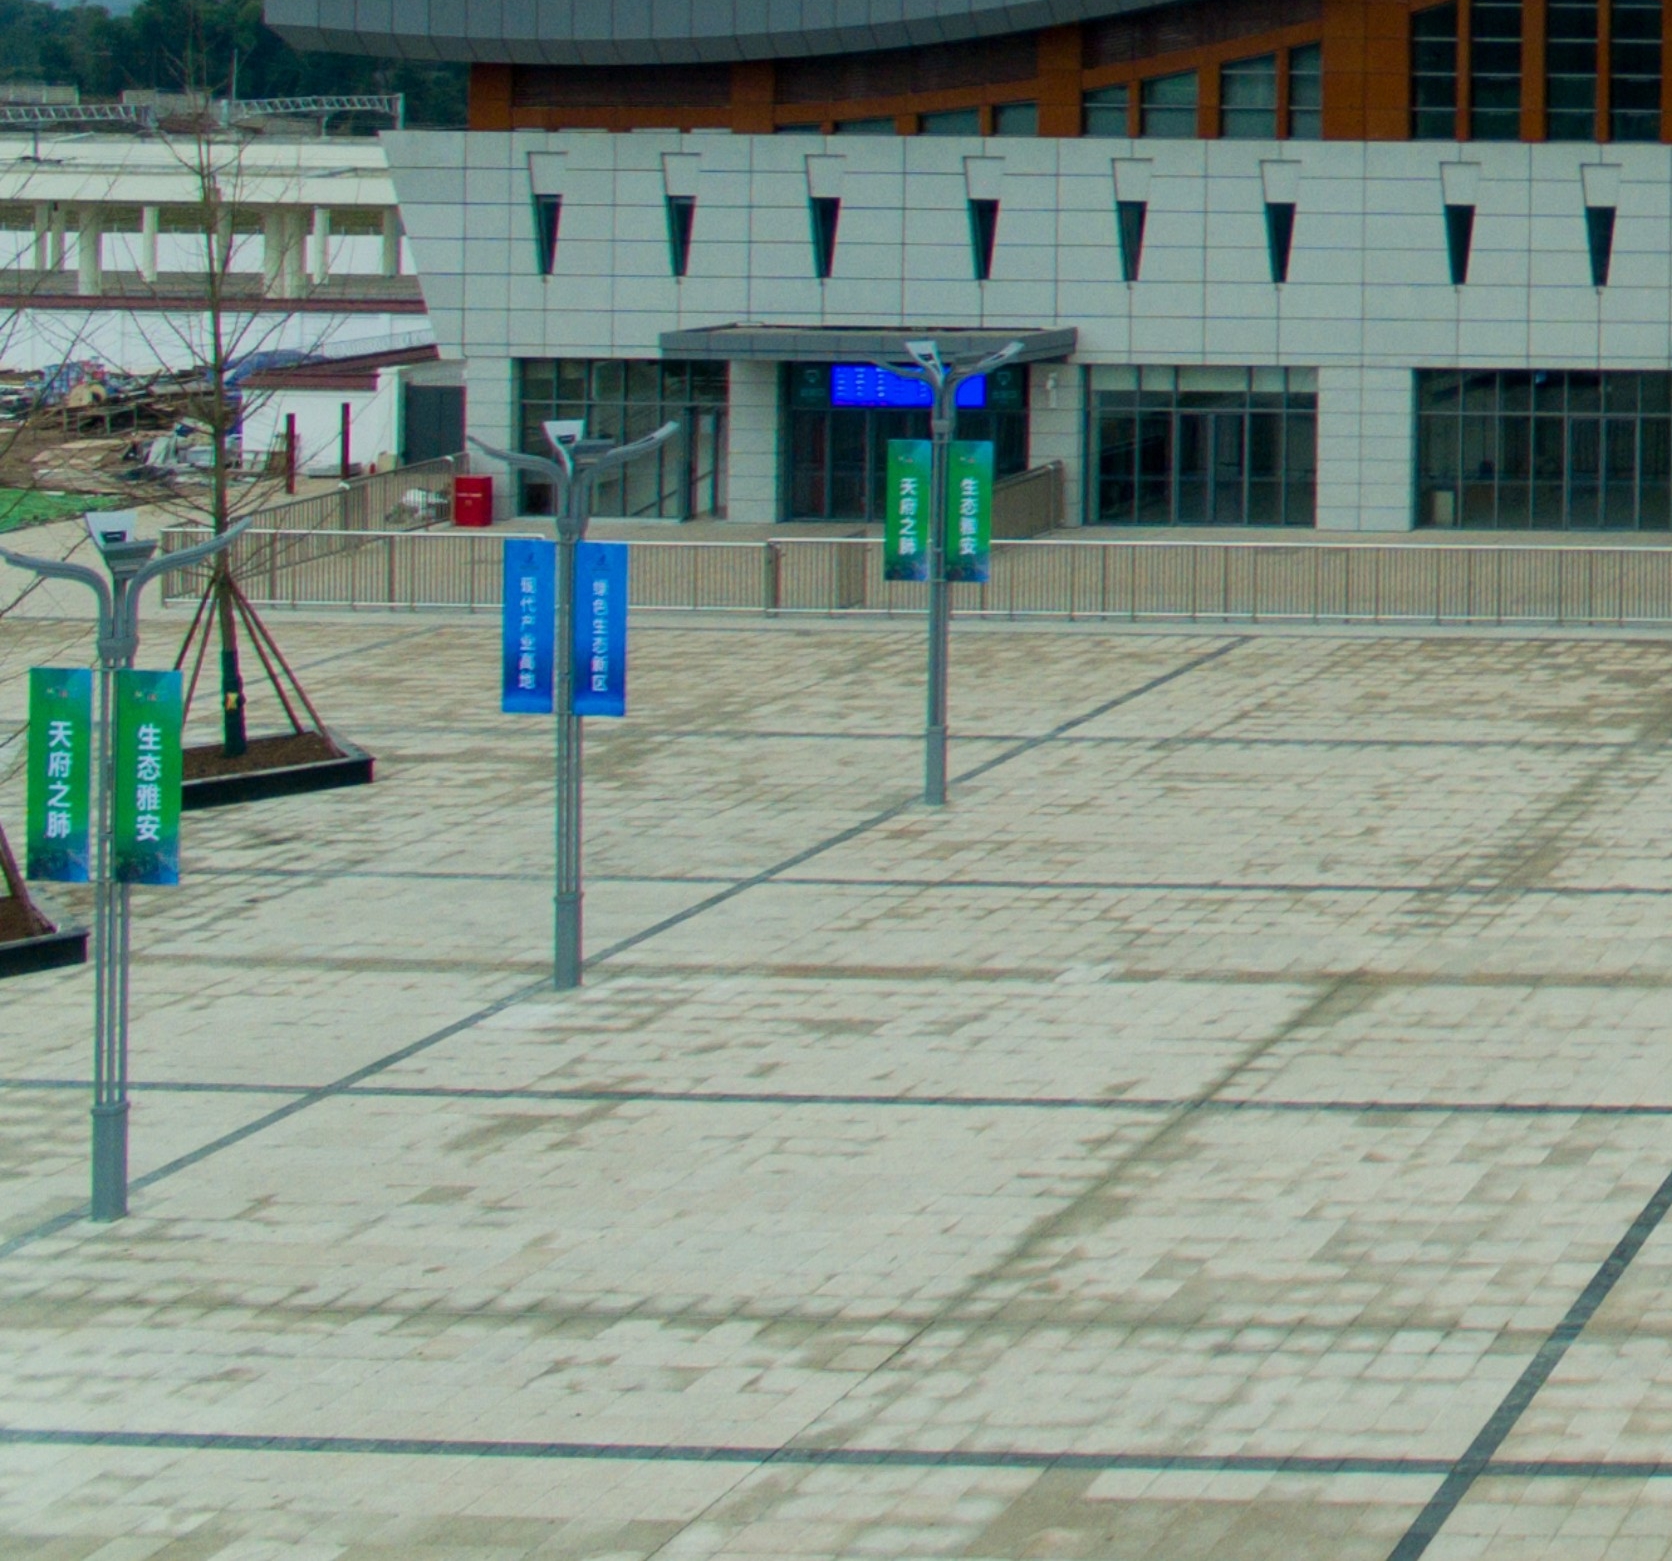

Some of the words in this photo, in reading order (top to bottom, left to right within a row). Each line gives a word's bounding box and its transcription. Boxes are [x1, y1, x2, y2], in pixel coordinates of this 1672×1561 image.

[959, 477, 979, 556] 生态雅安
[46, 720, 72, 839] 天府之肺
[135, 722, 162, 842] 生态雅安
